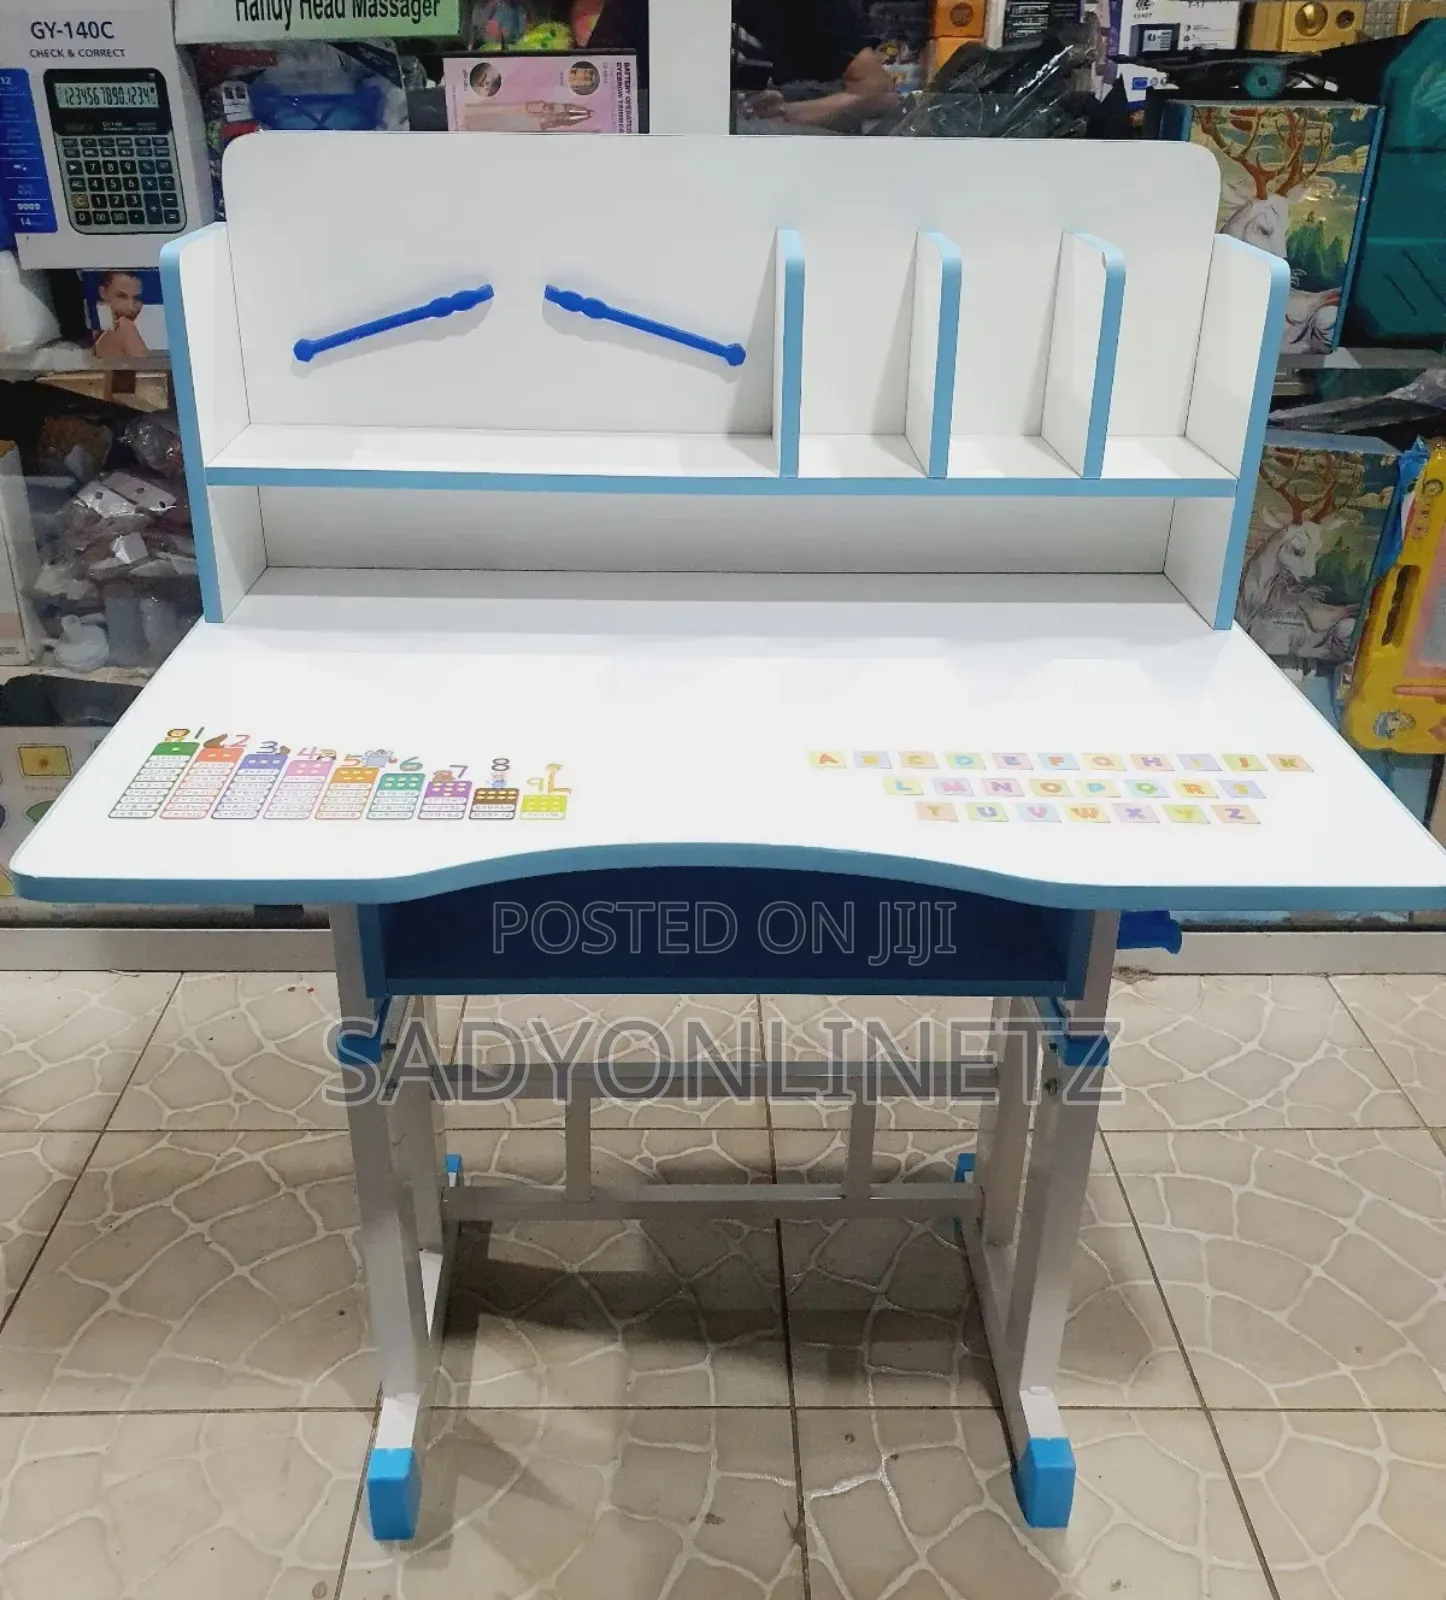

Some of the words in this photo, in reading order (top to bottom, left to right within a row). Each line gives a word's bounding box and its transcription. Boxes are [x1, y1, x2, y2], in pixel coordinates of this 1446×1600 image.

[300, 0, 345, 20] Head
[352, 0, 440, 24] Massager
[30, 21, 115, 39] GY-140C
[29, 49, 65, 58] CHECK
[67, 49, 75, 57] &
[77, 48, 125, 58] CORRECT
[90, 163, 96, 171] 7
[107, 163, 114, 171] 8
[124, 163, 131, 171] 9
[92, 180, 98, 188] 4
[110, 180, 117, 188] 5
[128, 180, 135, 188] 6
[95, 197, 101, 205] 1
[113, 196, 120, 204] 2
[131, 196, 138, 204] 3
[79, 213, 86, 221] 0
[194, 726, 206, 740] 1
[227, 734, 251, 748] 2
[256, 740, 278, 754] 3
[297, 746, 318, 760] 4
[341, 753, 363, 767] 5
[399, 756, 424, 772] 6
[449, 764, 469, 779] 7
[491, 757, 510, 772] 8
[526, 777, 545, 792] 9
[818, 753, 839, 765] A
[955, 754, 974, 766] D
[1141, 756, 1163, 767] H
[894, 780, 913, 791] L
[990, 781, 1013, 793] N
[1039, 781, 1063, 794] O
[925, 805, 944, 817] T
[975, 806, 998, 818] U
[1026, 806, 1048, 819] V
[1069, 806, 1100, 819] W
[1224, 807, 1246, 820] Z
